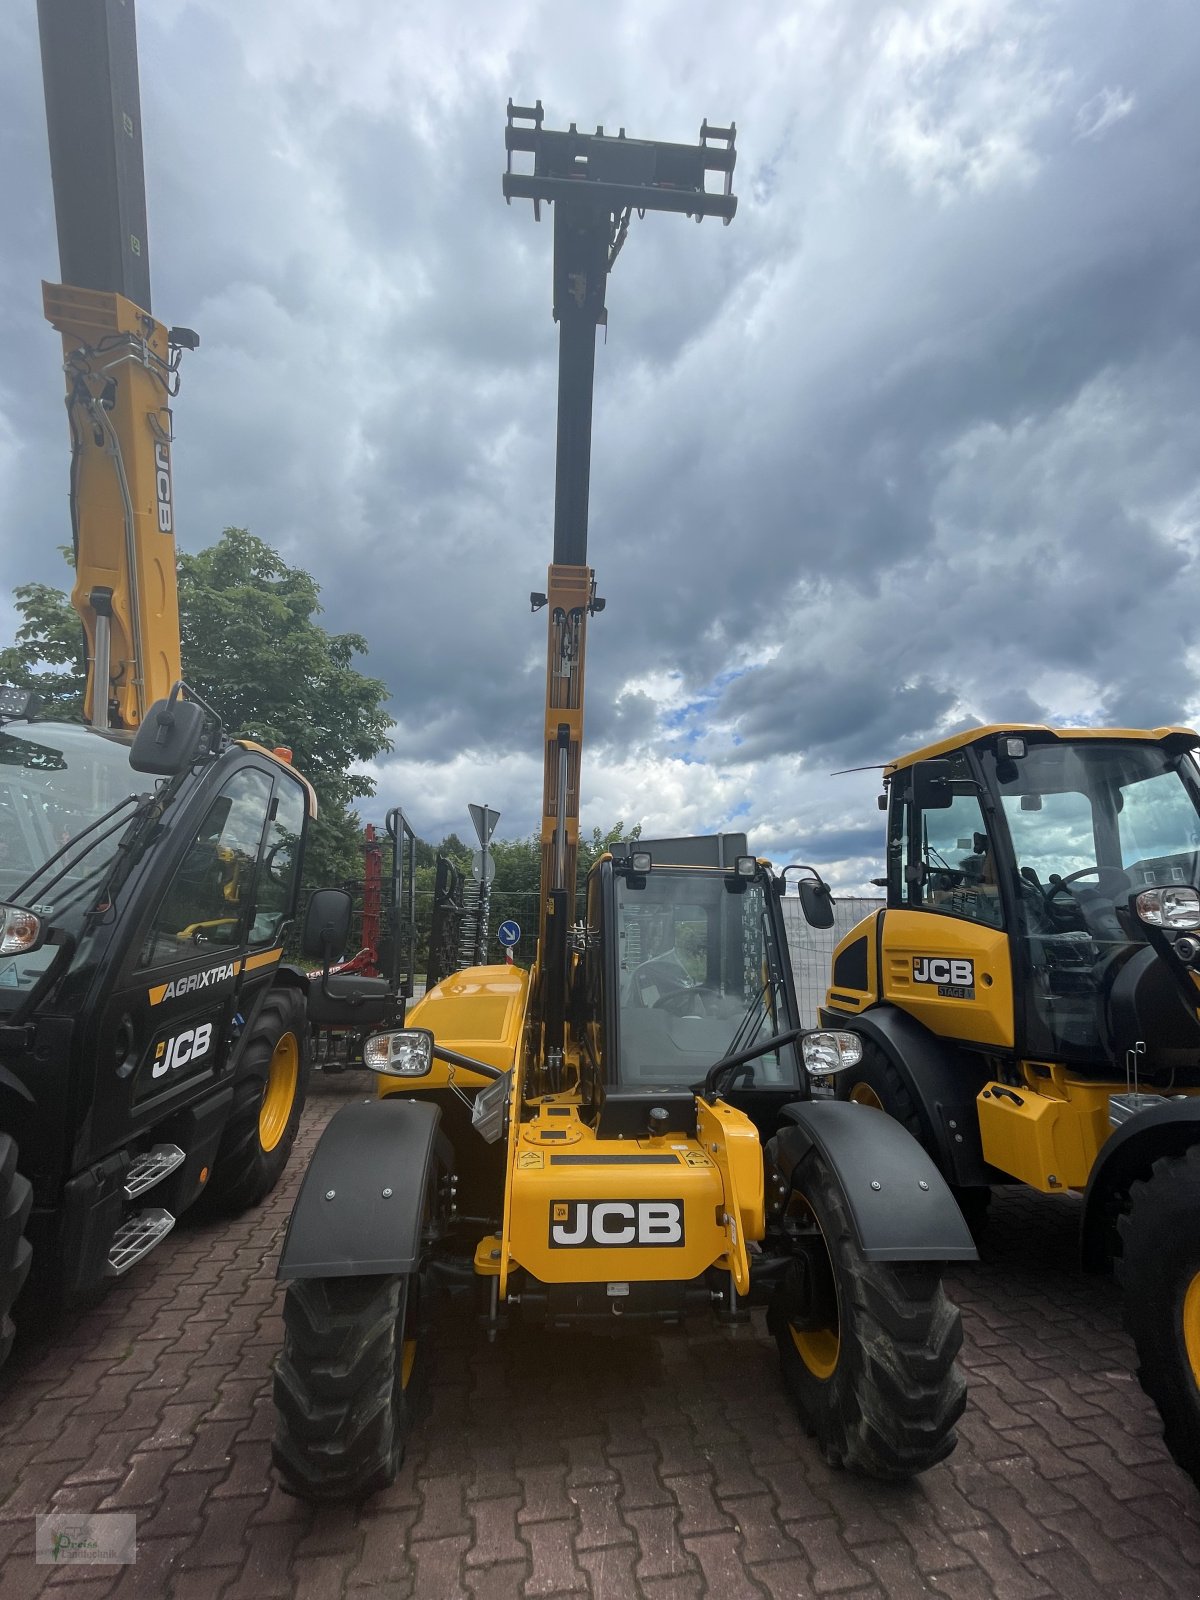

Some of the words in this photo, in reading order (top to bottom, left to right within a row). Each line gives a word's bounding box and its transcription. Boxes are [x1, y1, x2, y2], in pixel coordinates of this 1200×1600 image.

[155, 443, 172, 532] JCB
[31, 904, 54, 914] CB
[163, 962, 234, 1002] AGRIXTRA
[913, 958, 974, 986] JCB
[938, 987, 964, 998] STAGE
[152, 1022, 213, 1079] JCB
[552, 1202, 682, 1244] JCB
